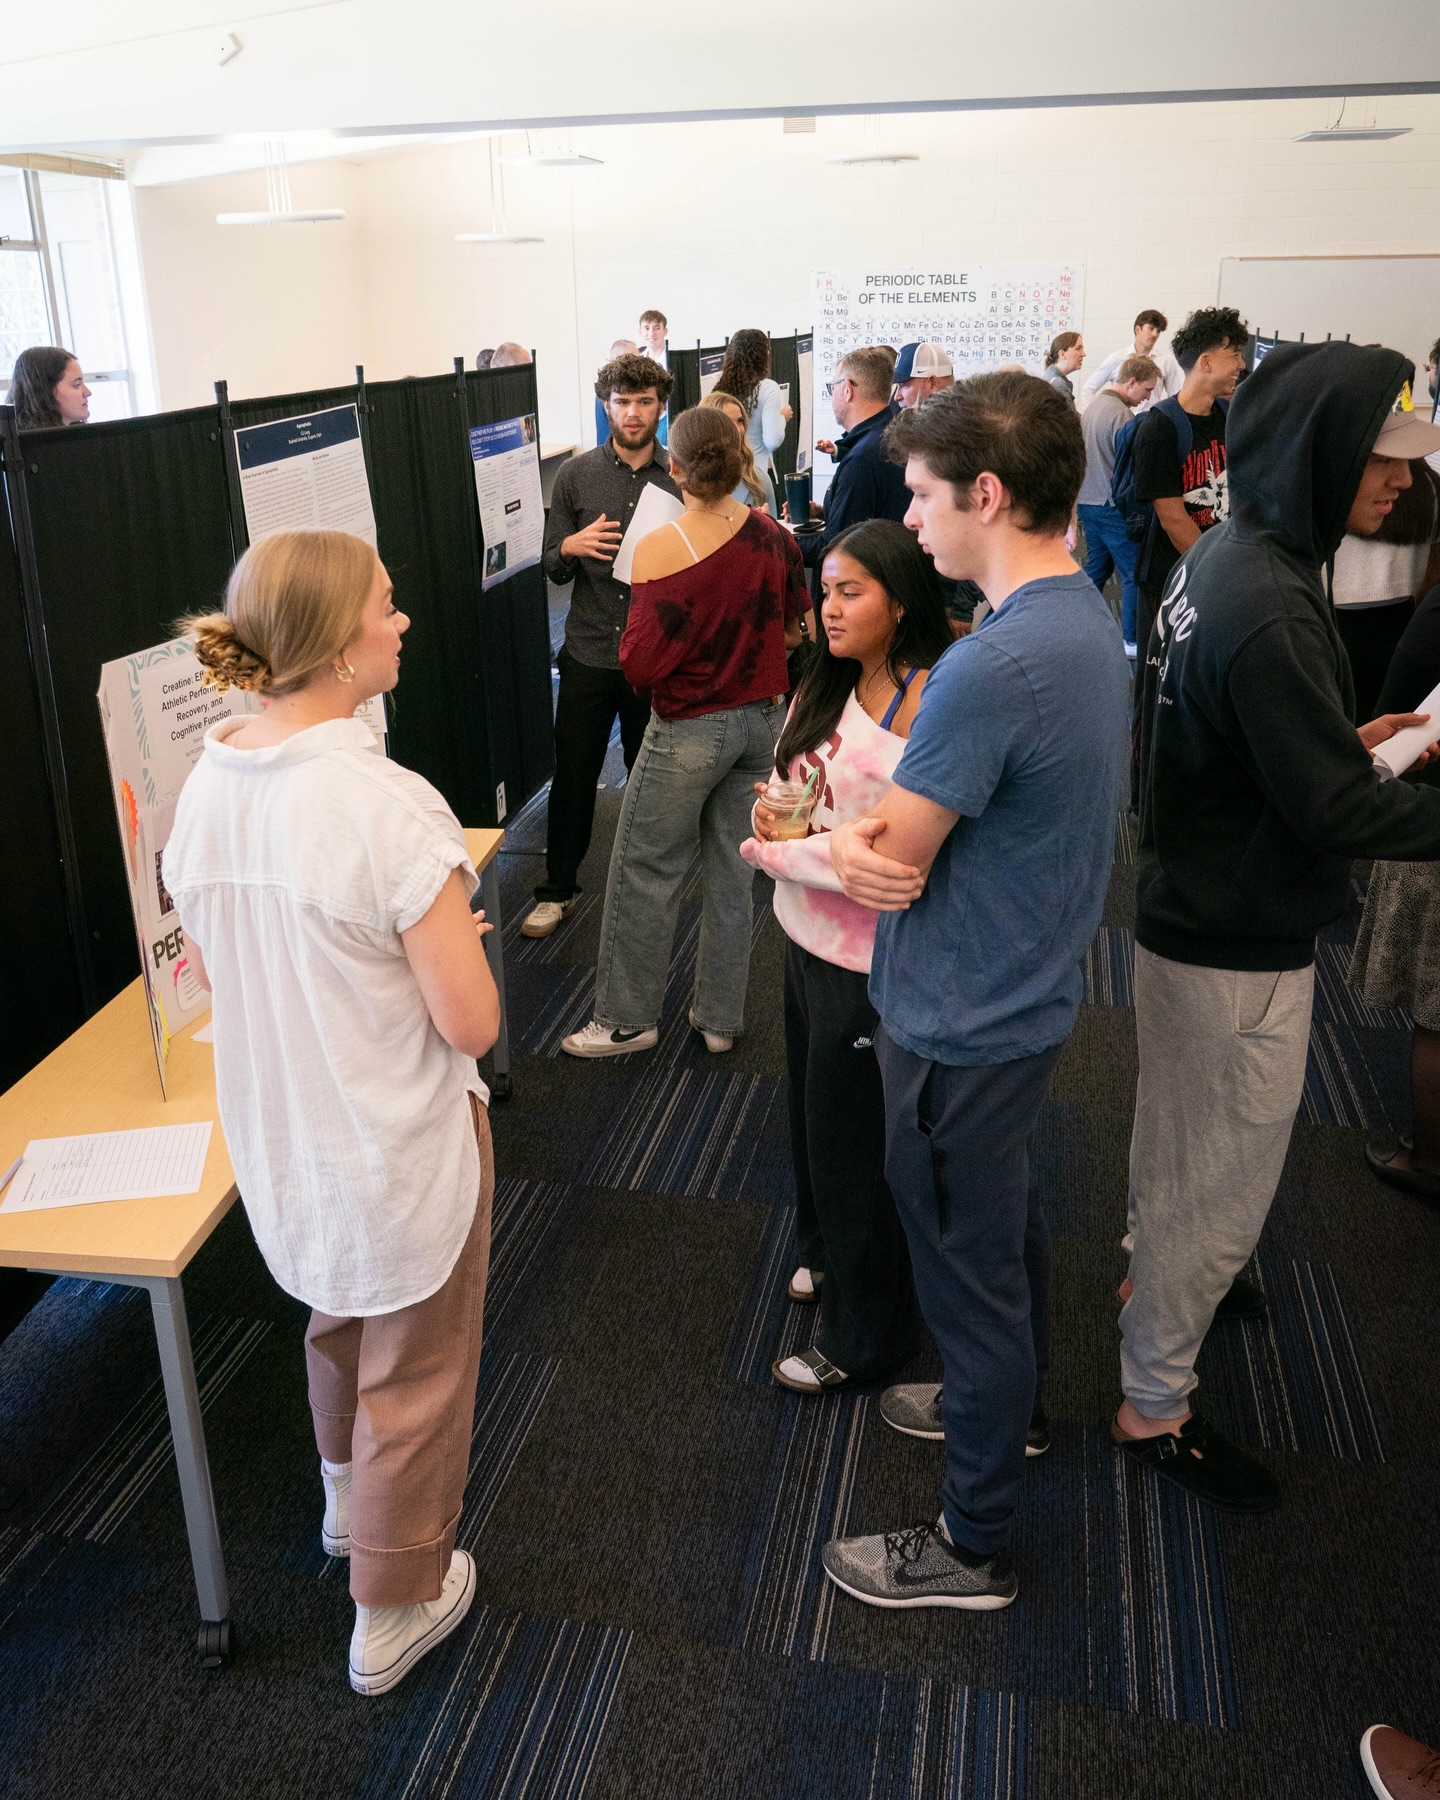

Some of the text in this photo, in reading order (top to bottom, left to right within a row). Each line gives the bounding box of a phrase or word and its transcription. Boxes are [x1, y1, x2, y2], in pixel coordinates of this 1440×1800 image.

[866, 273, 968, 287] PERIODIC TABLE
[1060, 275, 1072, 283] He
[825, 294, 848, 302] Li Be
[858, 290, 977, 305] OF THE ELEMENTS
[991, 291, 997, 299] B
[1005, 291, 1012, 299] C
[1033, 290, 1040, 298] O
[1048, 290, 1054, 298] F
[1060, 290, 1070, 298] Ne
[836, 308, 849, 317] Mg
[1033, 305, 1039, 313] S
[1046, 305, 1054, 313] Cl
[1059, 305, 1069, 313] Ar
[850, 322, 861, 330] Sc
[866, 322, 873, 330] Ti
[932, 321, 943, 329] Co
[947, 321, 955, 329] Ni
[959, 321, 970, 329] Cu
[974, 321, 984, 329] Zn
[987, 321, 999, 329] Ga
[1015, 320, 1026, 328] As
[1030, 320, 1040, 328] Se
[1044, 320, 1054, 328] Br
[823, 337, 834, 345] Rb
[877, 336, 888, 344] Nb
[890, 336, 902, 344] Mo
[946, 335, 956, 343] Pd
[959, 336, 970, 344] Ag
[973, 335, 984, 343] Cd
[823, 351, 834, 359] Cs
[972, 350, 984, 358] Hg
[1016, 349, 1023, 357] Bi
[1029, 349, 1039, 357] Po
[162, 676, 194, 695] Creatine:
[161, 693, 188, 712] Athletic
[176, 696, 224, 723] Recovery, and
[170, 722, 203, 741] Cognitive
[203, 708, 232, 727] Function
